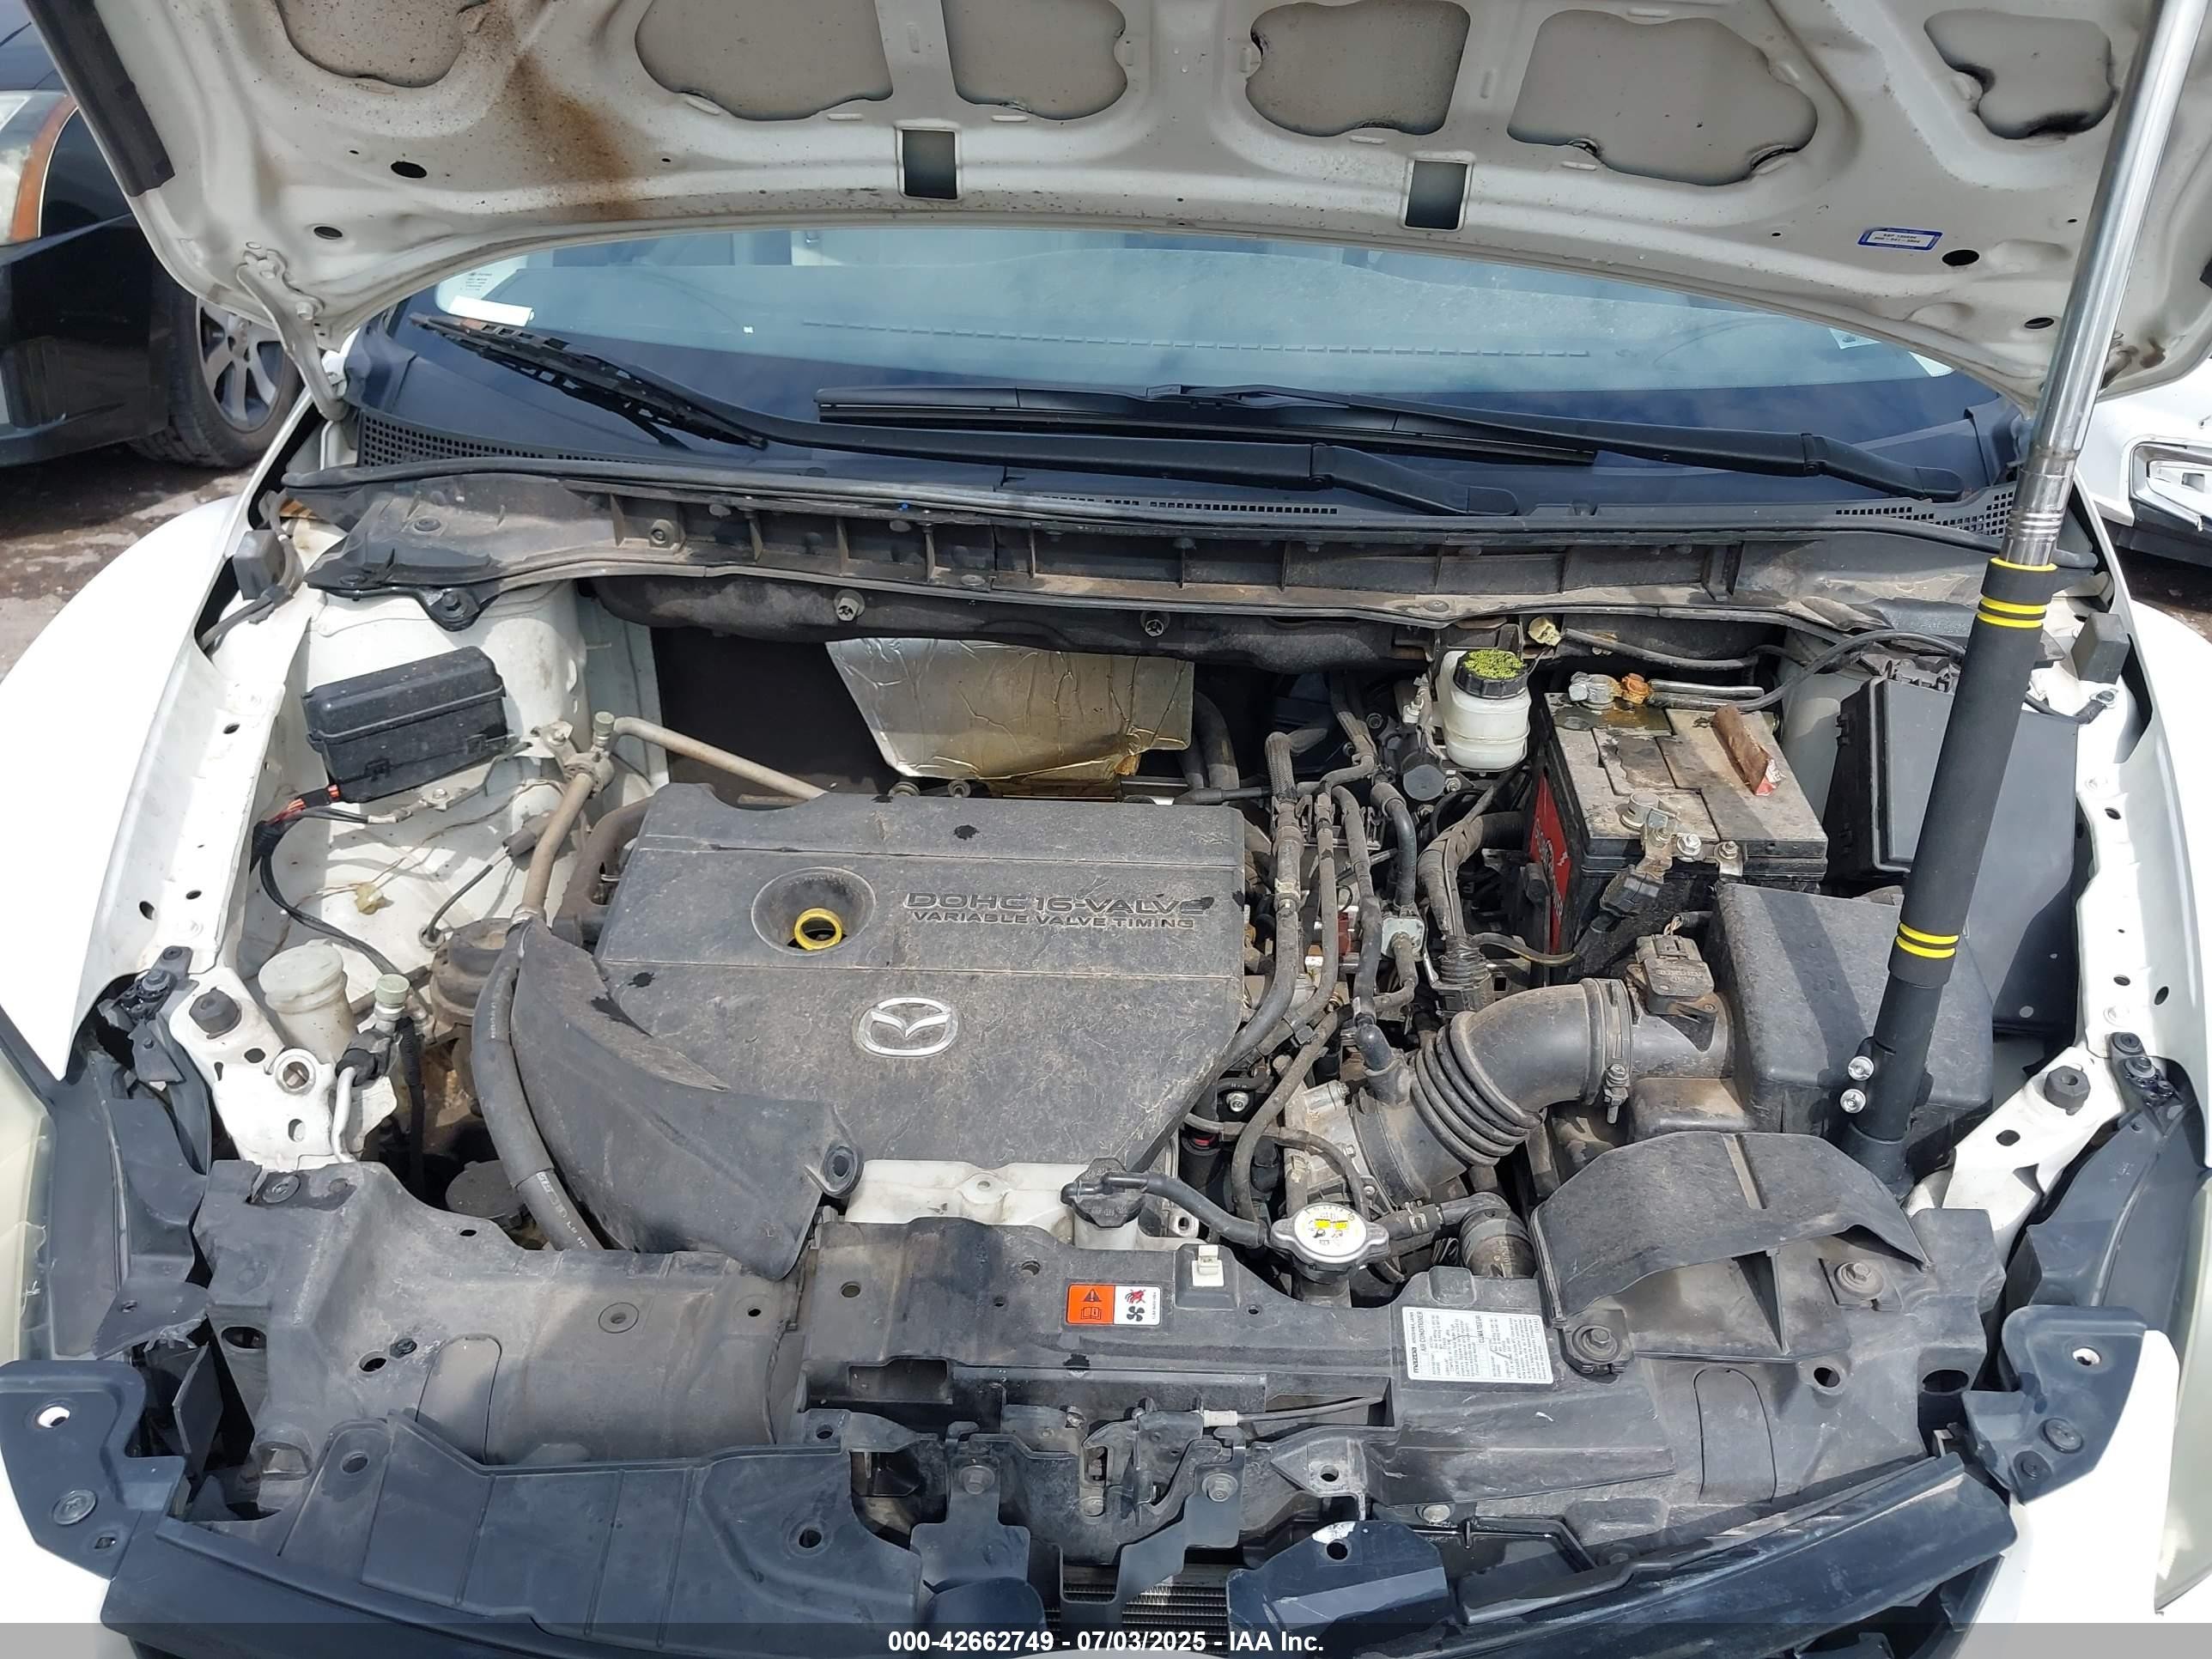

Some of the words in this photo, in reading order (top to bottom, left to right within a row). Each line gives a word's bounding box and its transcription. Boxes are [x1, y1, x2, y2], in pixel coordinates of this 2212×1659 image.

[904, 892, 1027, 911] DOHC
[913, 911, 1029, 924] VARIABLE
[1036, 915, 1107, 927] VALVE
[1113, 917, 1195, 928] TIMING
